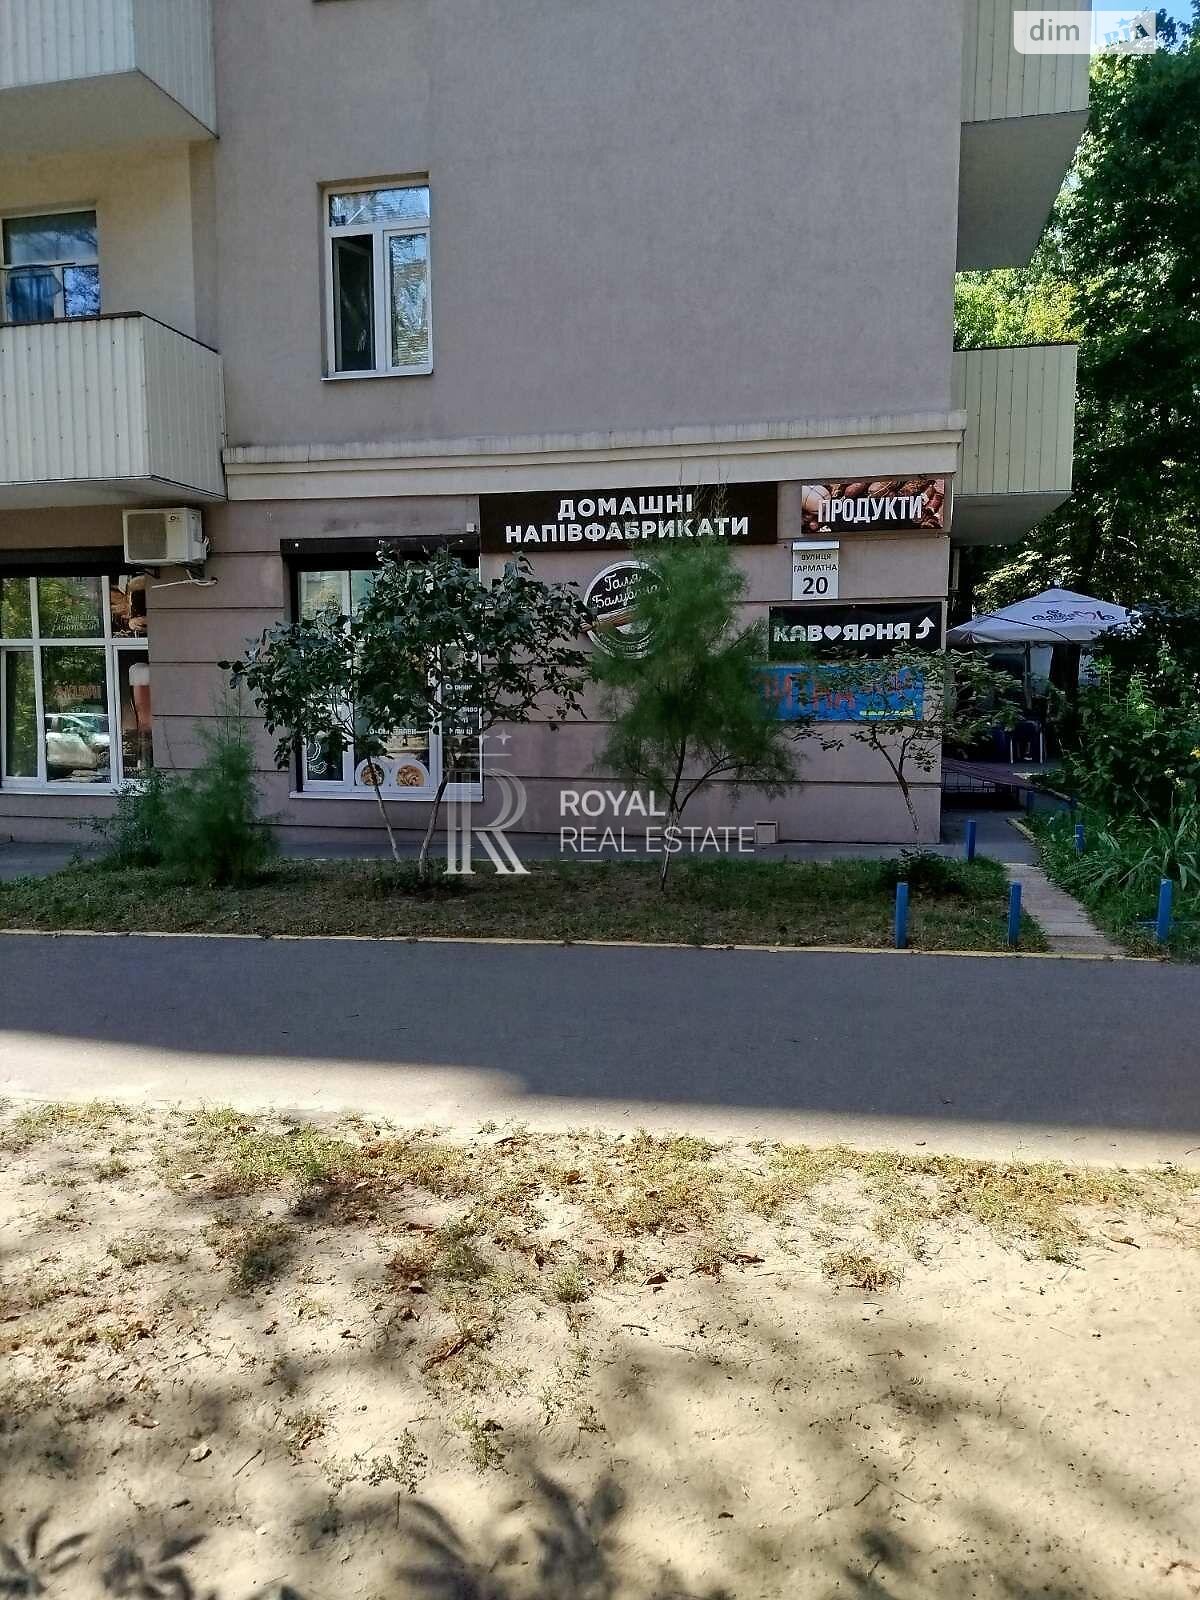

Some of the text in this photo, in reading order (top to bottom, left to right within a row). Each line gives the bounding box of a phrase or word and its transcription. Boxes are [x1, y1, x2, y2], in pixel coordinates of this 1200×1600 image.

[557, 494, 693, 521] ДОМАШНІ
[817, 495, 922, 523] ПРОДУКТИ
[505, 516, 749, 544] НАПІВФАБРИКАТИ
[793, 563, 838, 572] ГАРМАТНА
[802, 576, 829, 595] 20
